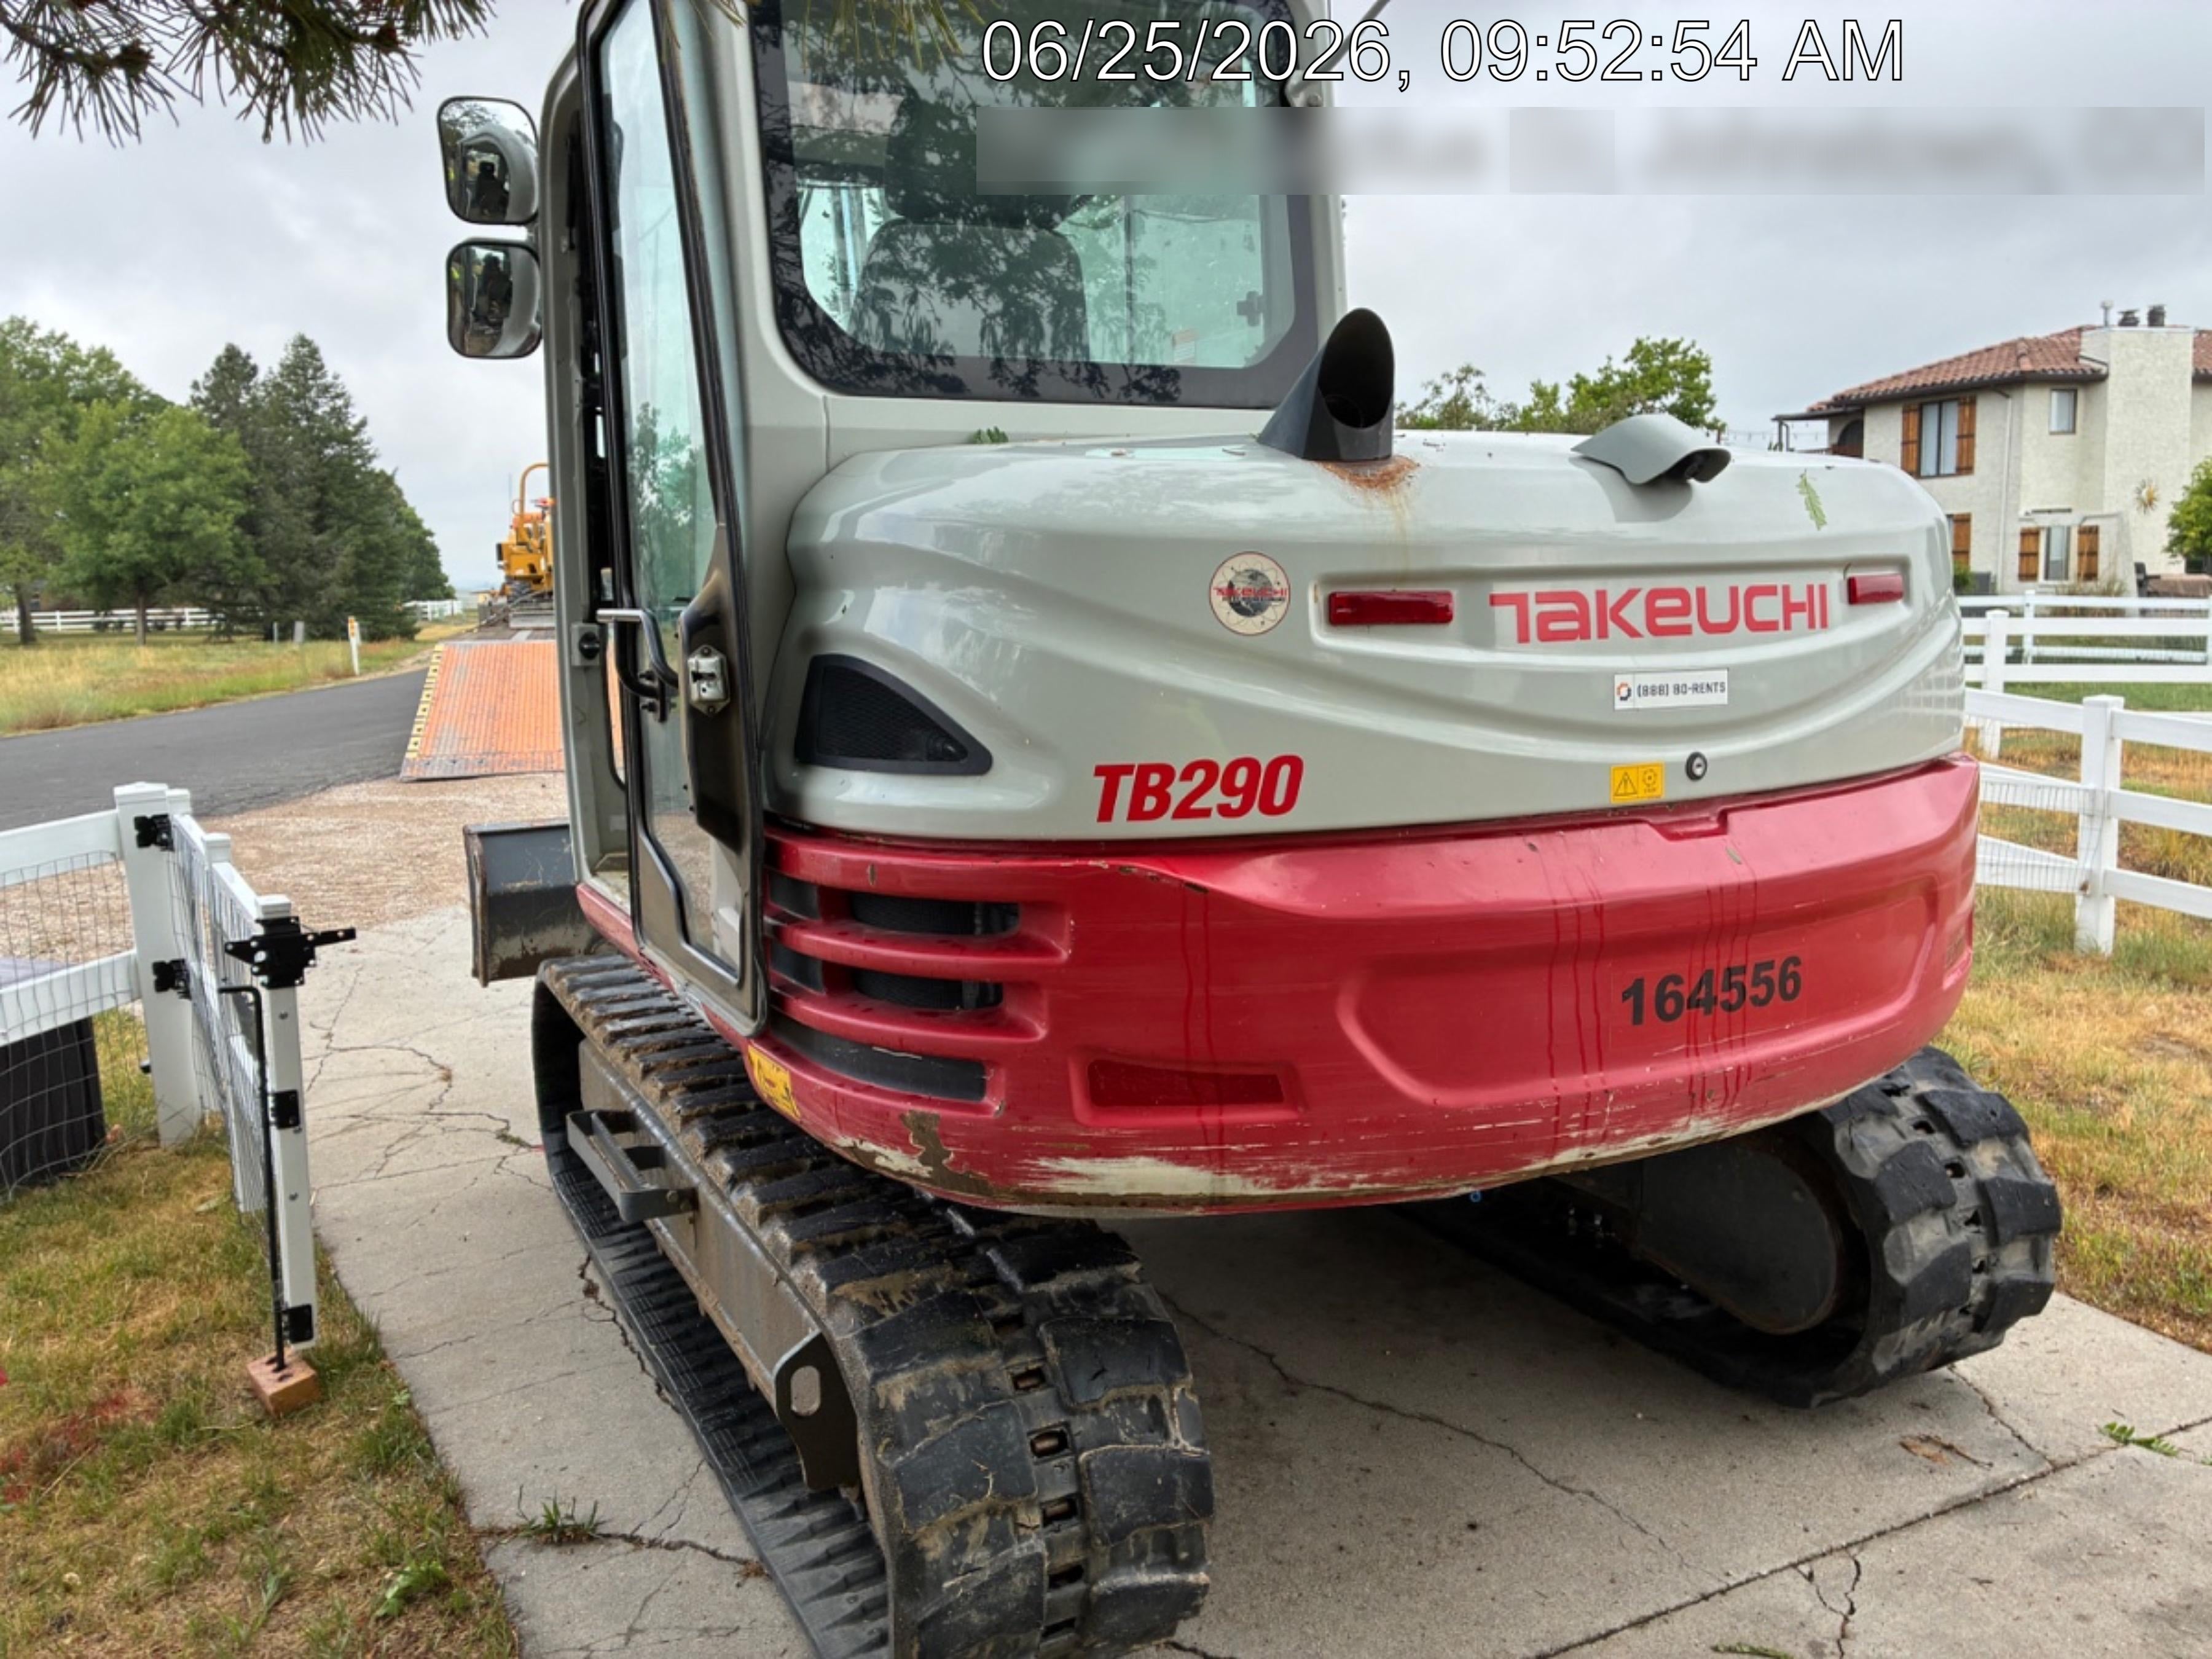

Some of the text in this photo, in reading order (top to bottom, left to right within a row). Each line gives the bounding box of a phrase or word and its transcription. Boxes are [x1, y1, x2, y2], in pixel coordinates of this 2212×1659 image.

[1489, 584, 1829, 643] TAKEUCHI
[1637, 683, 1669, 697] (888)
[1093, 755, 1304, 823] TB290
[1622, 955, 1802, 1026] 164556
